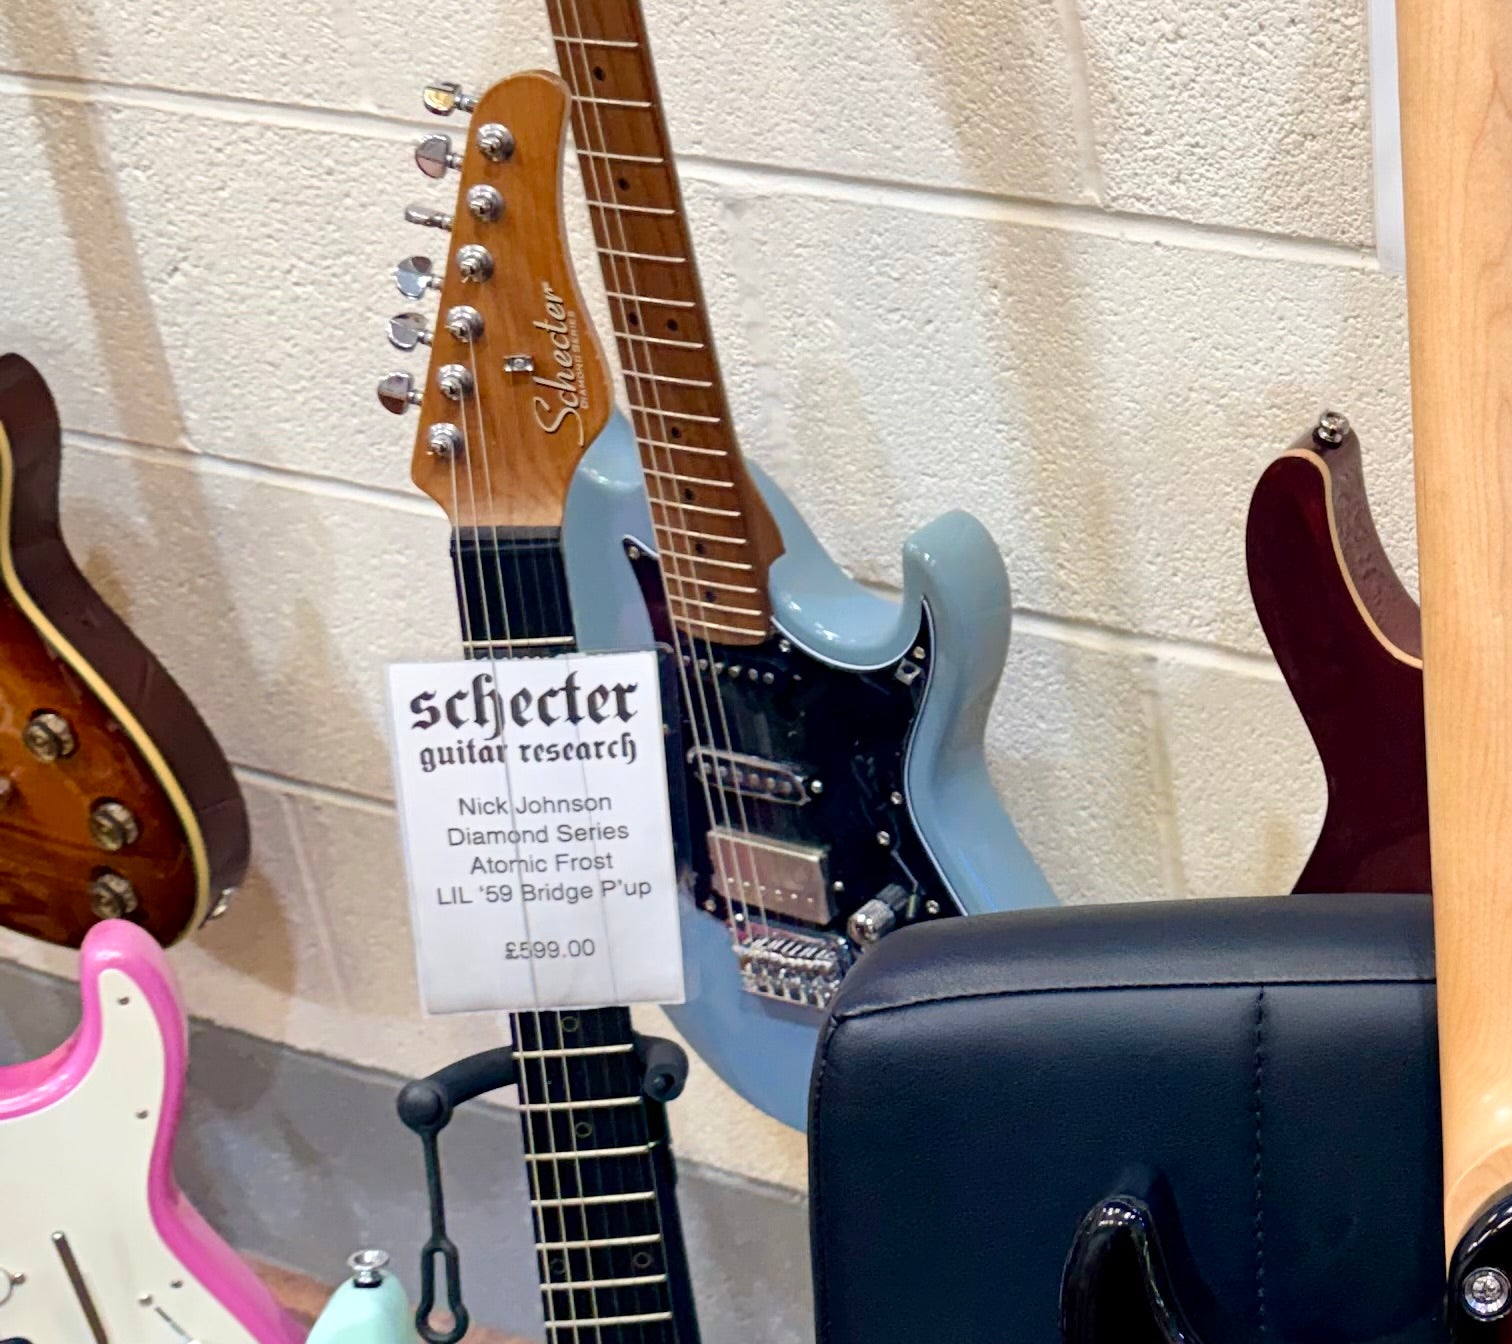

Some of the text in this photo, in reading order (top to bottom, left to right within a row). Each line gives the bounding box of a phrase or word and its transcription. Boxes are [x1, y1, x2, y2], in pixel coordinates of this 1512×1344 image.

[533, 280, 585, 447] Schecter
[409, 670, 639, 741] schecter
[419, 731, 638, 773] guitar research
[458, 795, 613, 816] Nick Johnson
[447, 822, 630, 847] Diamond Series
[470, 852, 614, 875] Atomic Frost
[436, 886, 473, 905] LIL
[520, 882, 594, 905] Bridge
[505, 938, 596, 960] £599.00
